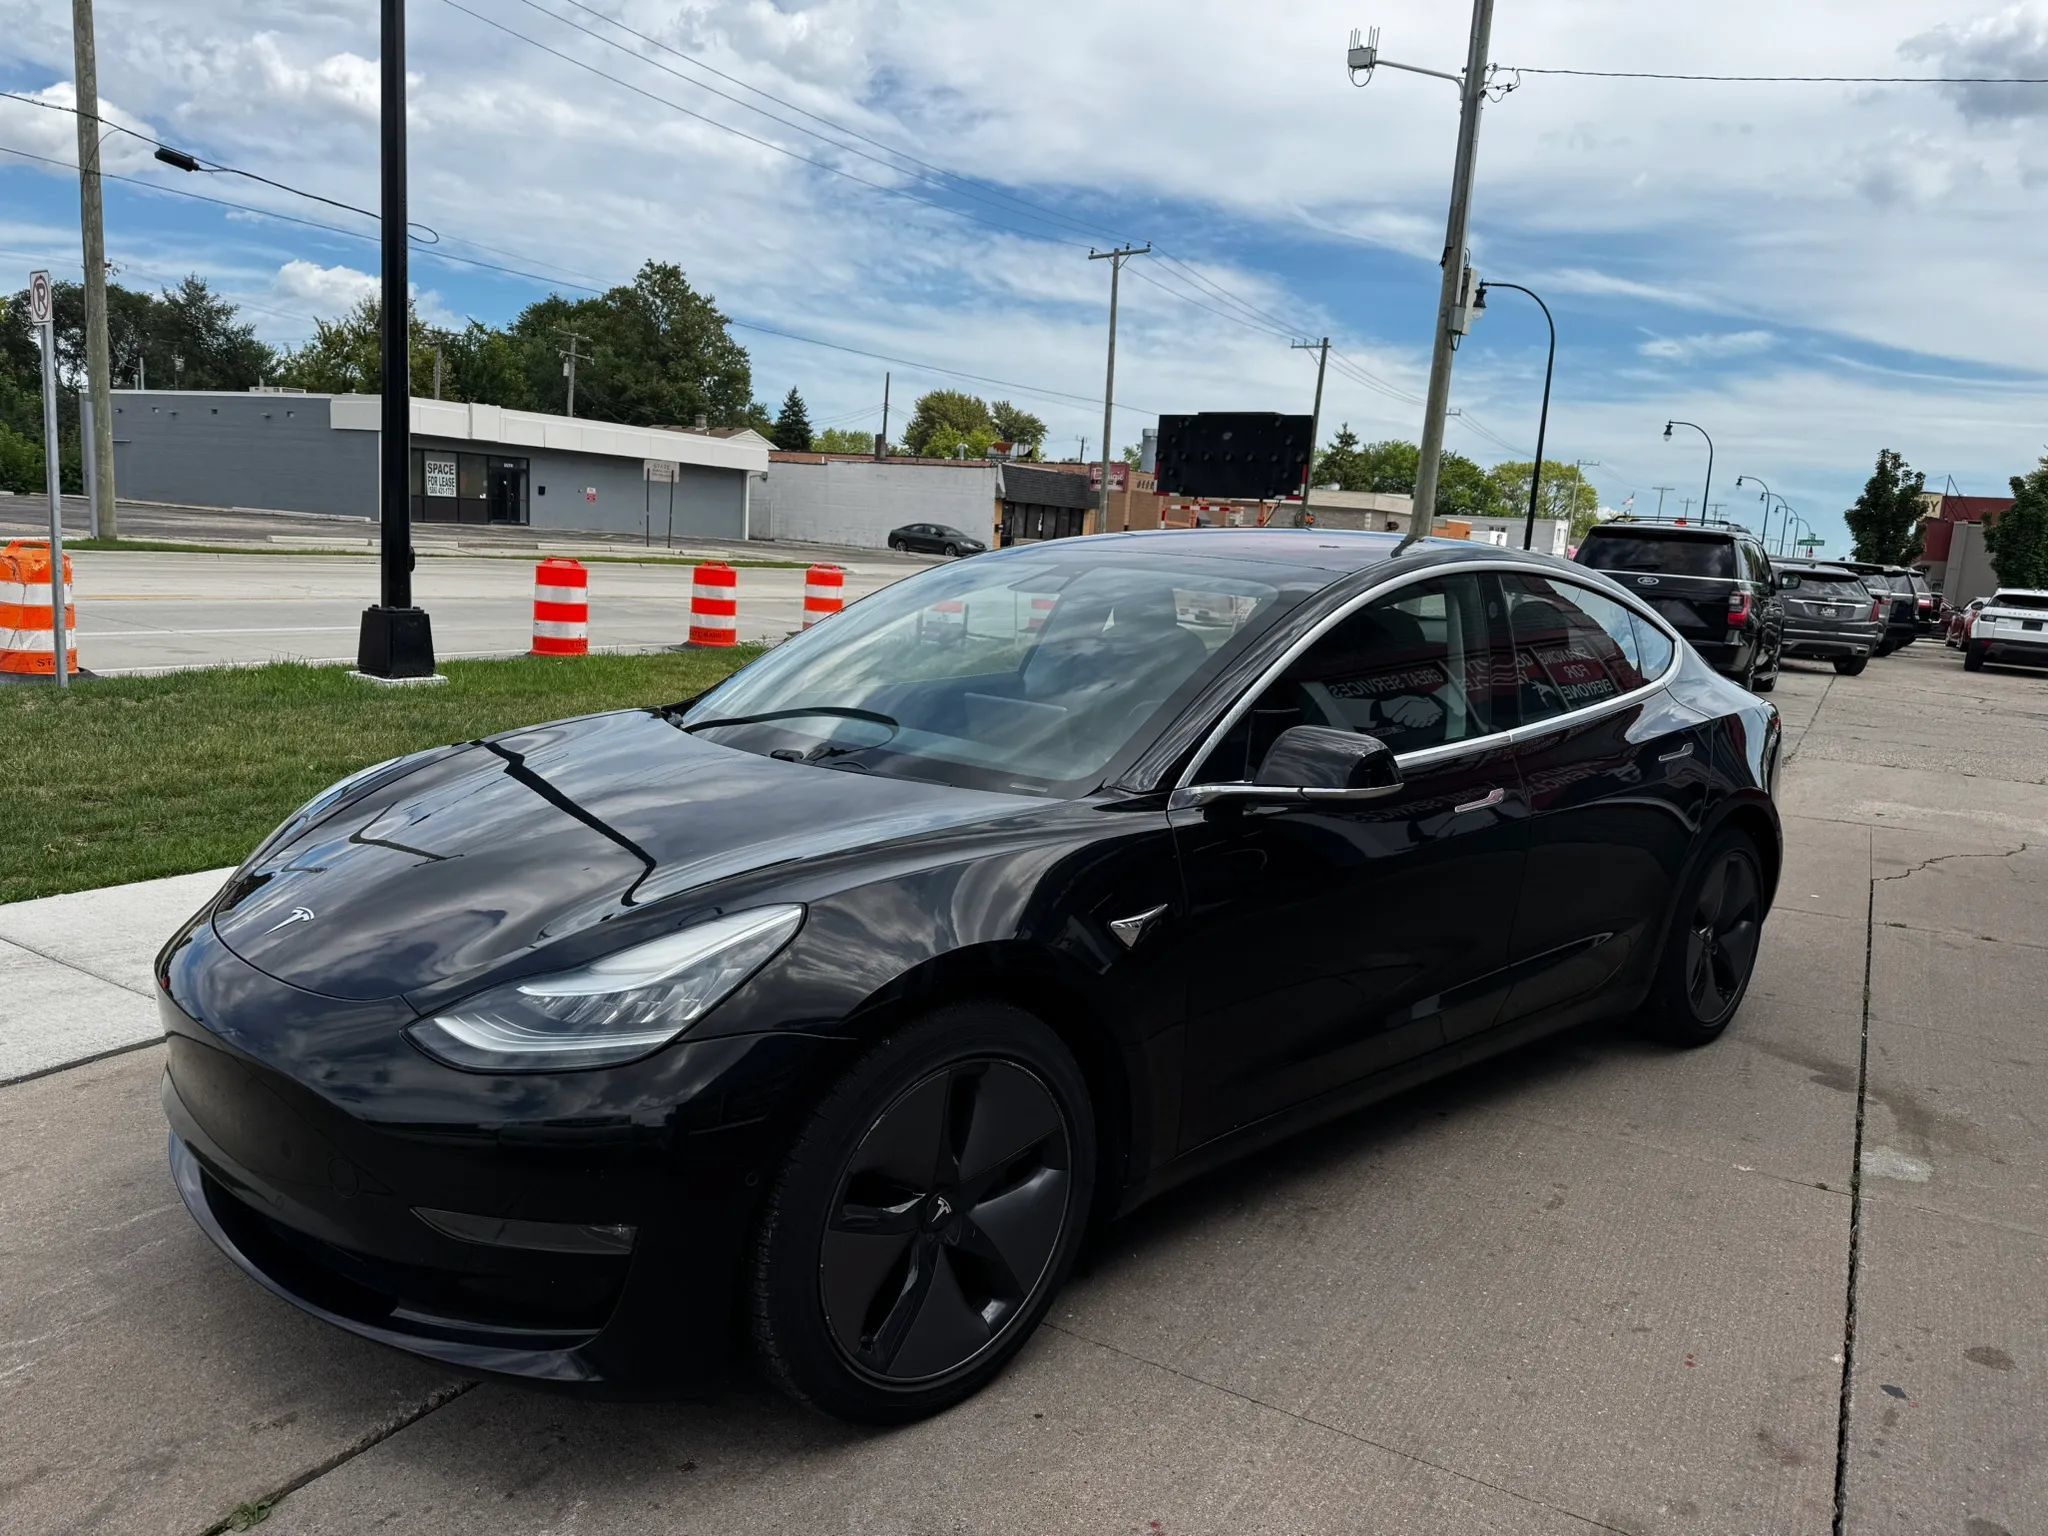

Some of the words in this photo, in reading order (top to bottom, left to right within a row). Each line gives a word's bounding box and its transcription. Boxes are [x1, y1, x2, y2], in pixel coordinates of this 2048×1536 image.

[427, 462, 454, 475] SPACE
[428, 476, 438, 486] FOR
[439, 477, 455, 487] LEASE
